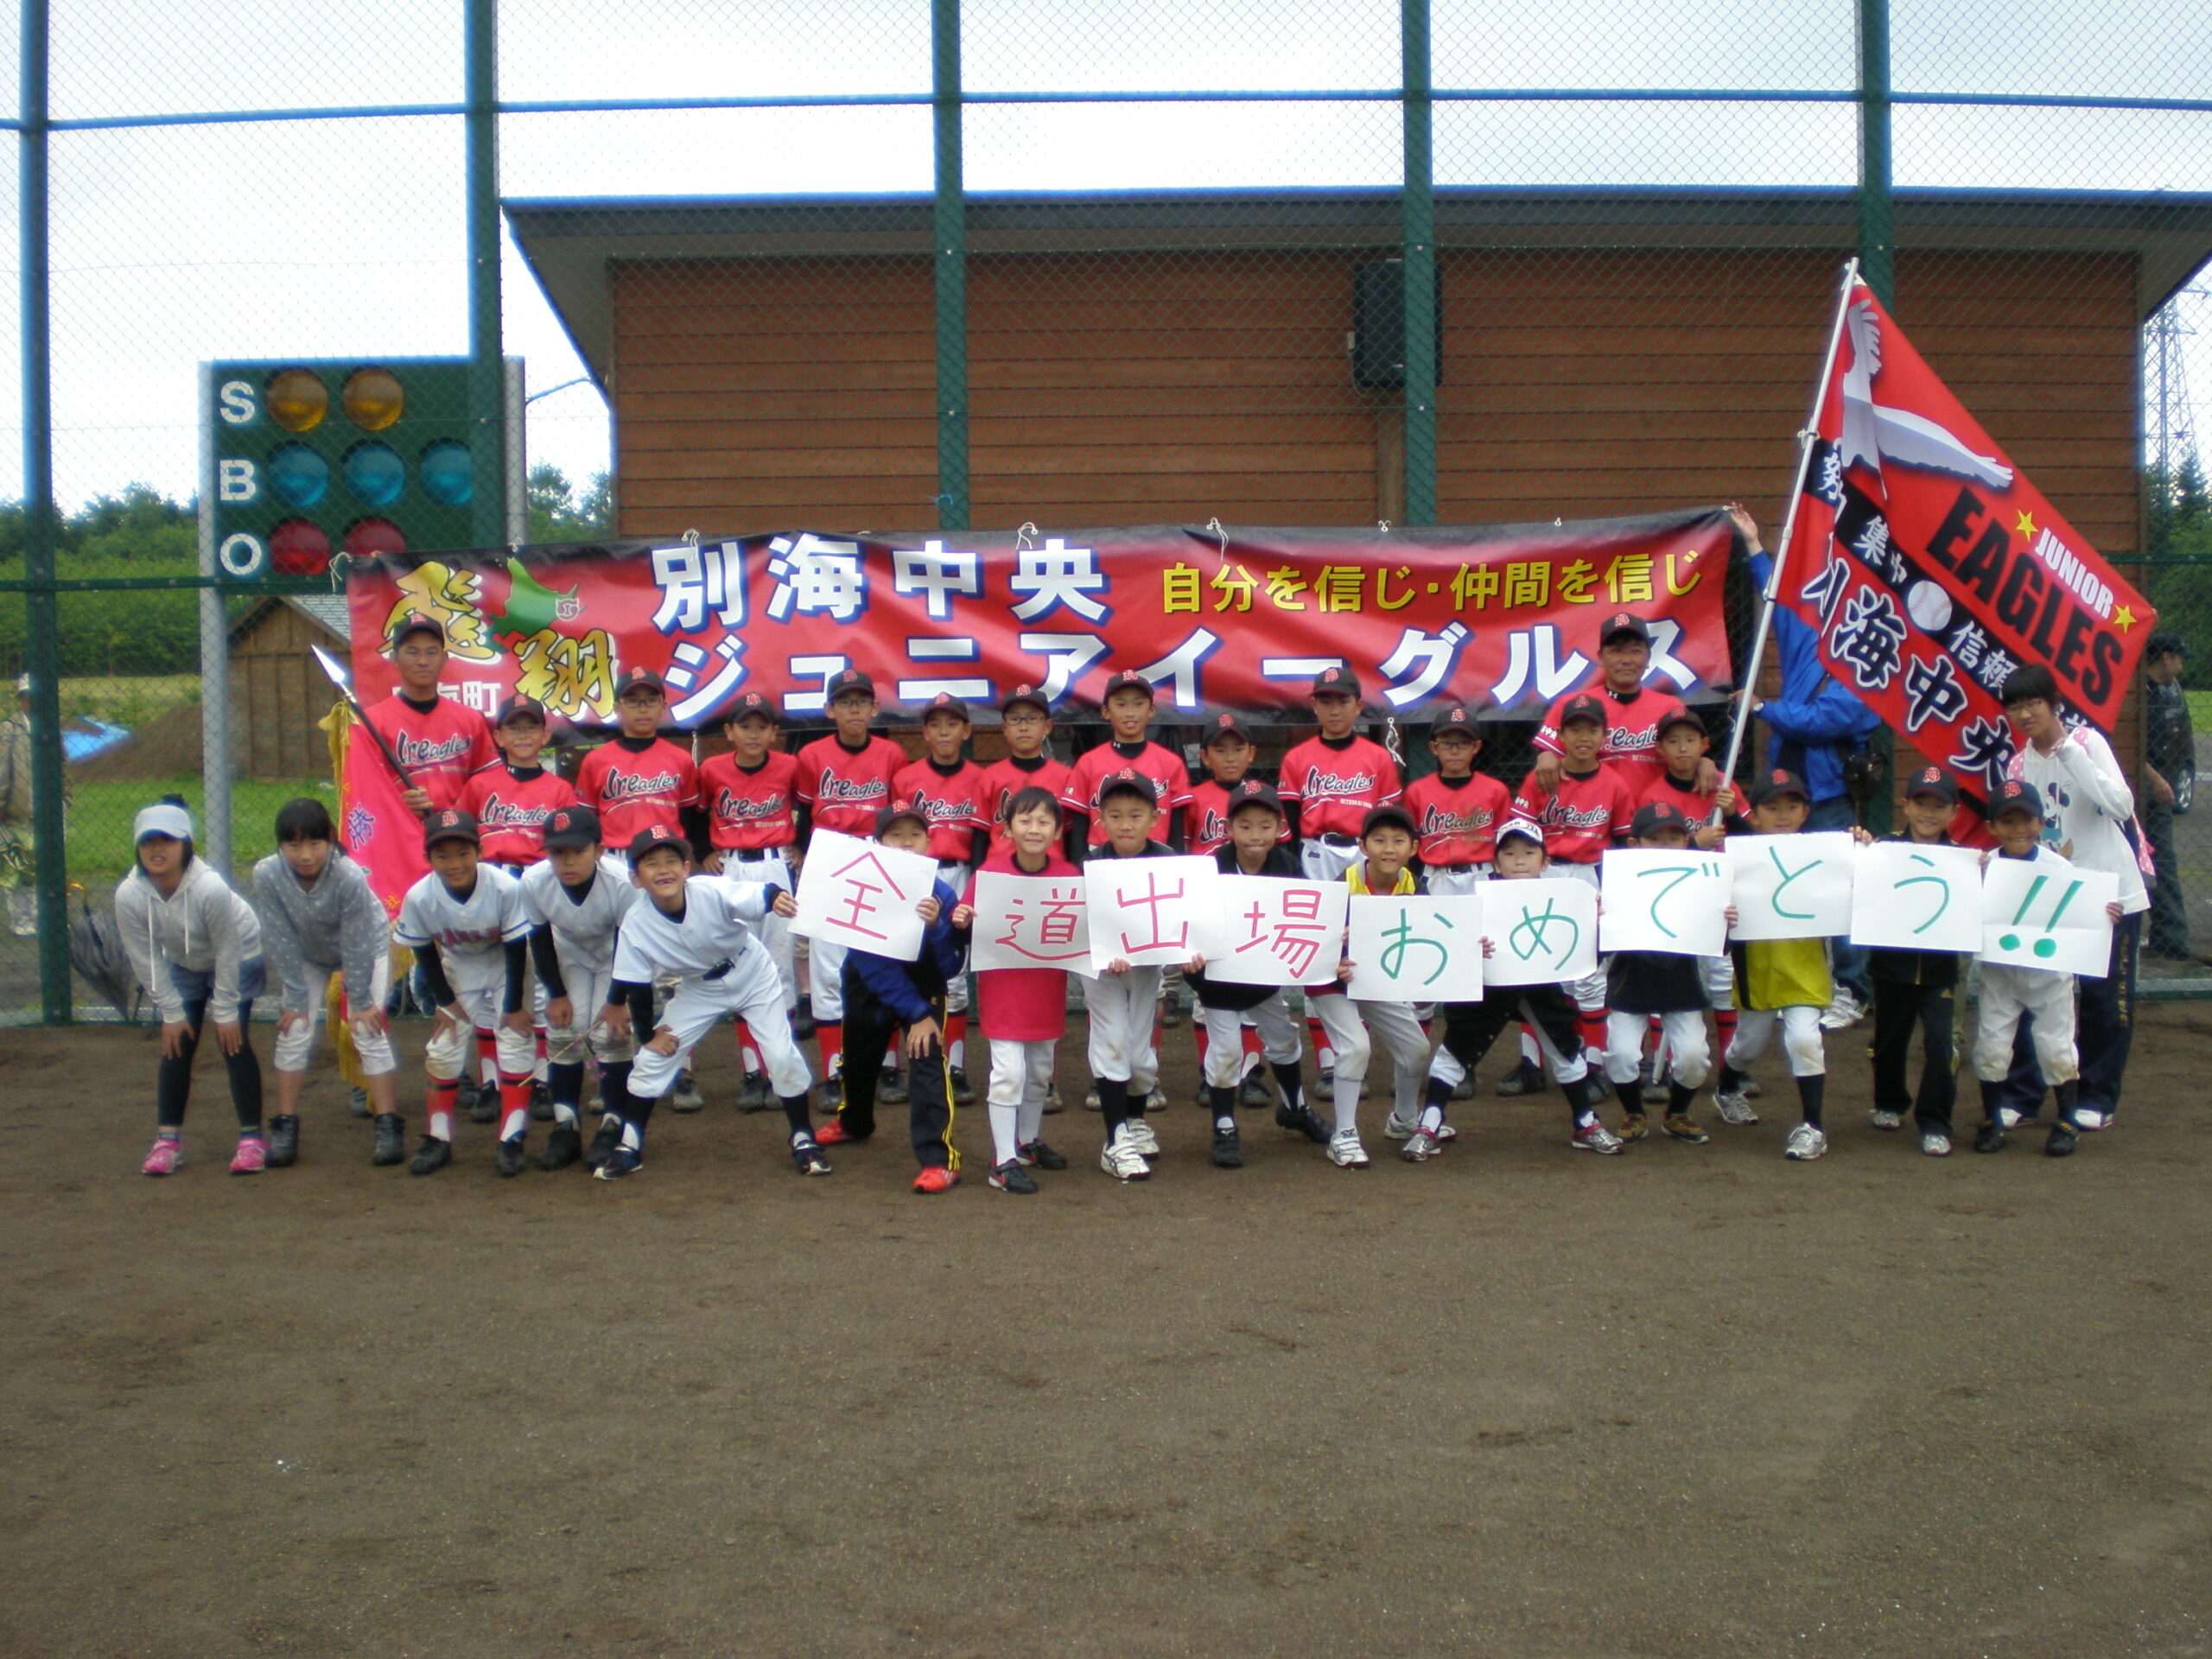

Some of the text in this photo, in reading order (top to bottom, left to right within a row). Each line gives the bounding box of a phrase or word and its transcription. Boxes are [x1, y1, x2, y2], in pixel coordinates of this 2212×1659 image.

[219, 380, 257, 424] S
[219, 459, 257, 501] B
[219, 532, 263, 576] O
[652, 533, 1108, 631] 別海中央
[1162, 550, 1700, 613] 自分を信じ・仲間を信じ
[2034, 527, 2114, 620] JUNIOR
[1925, 486, 2123, 706] EAGLES
